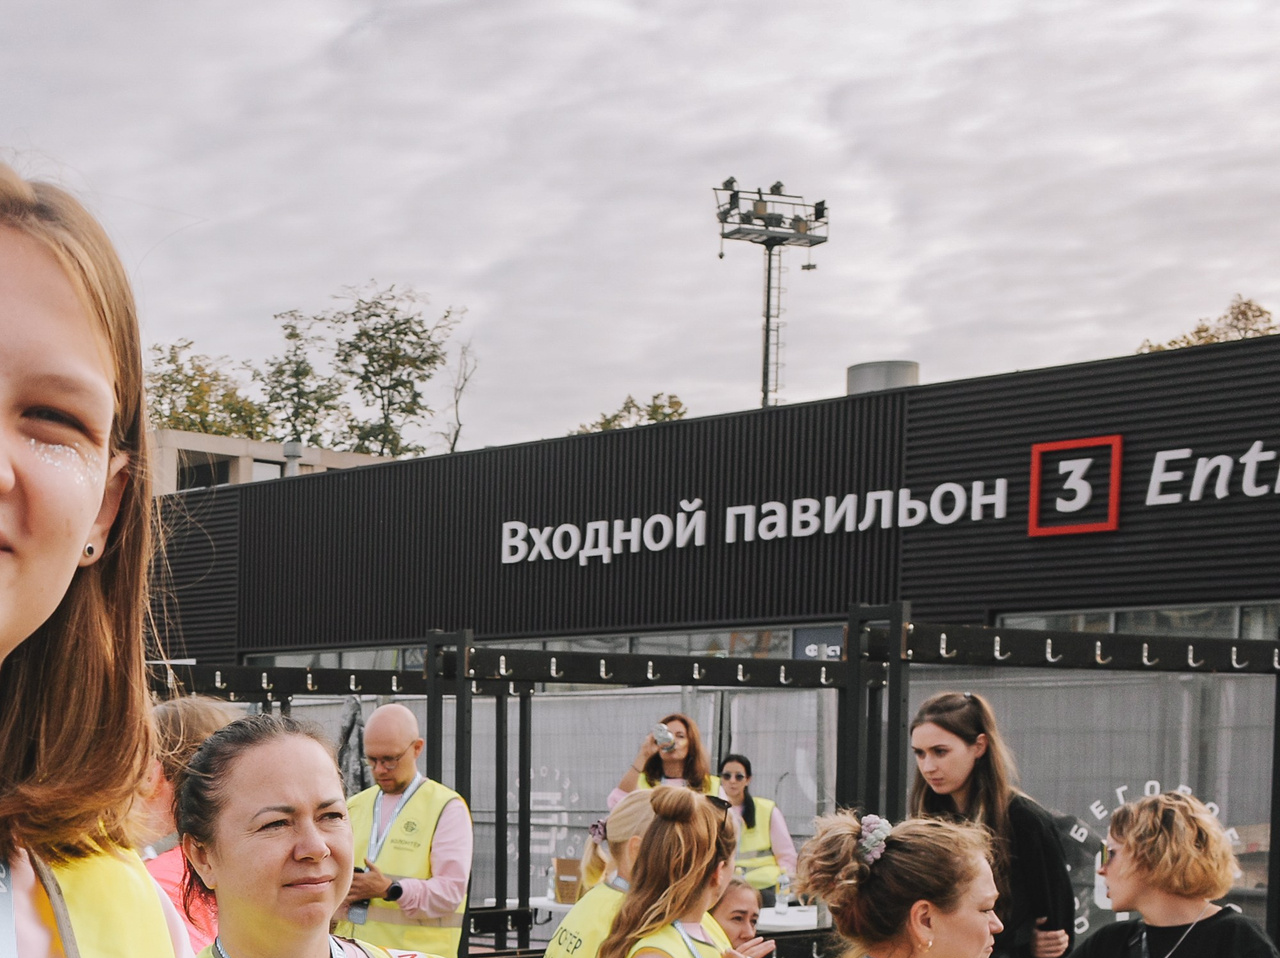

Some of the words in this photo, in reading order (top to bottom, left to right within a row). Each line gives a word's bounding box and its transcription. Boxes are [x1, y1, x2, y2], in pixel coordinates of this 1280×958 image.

[501, 498, 707, 566] Входной
[725, 477, 1008, 544] павильон
[1055, 457, 1094, 513] 3
[1145, 440, 1280, 506] Ent
